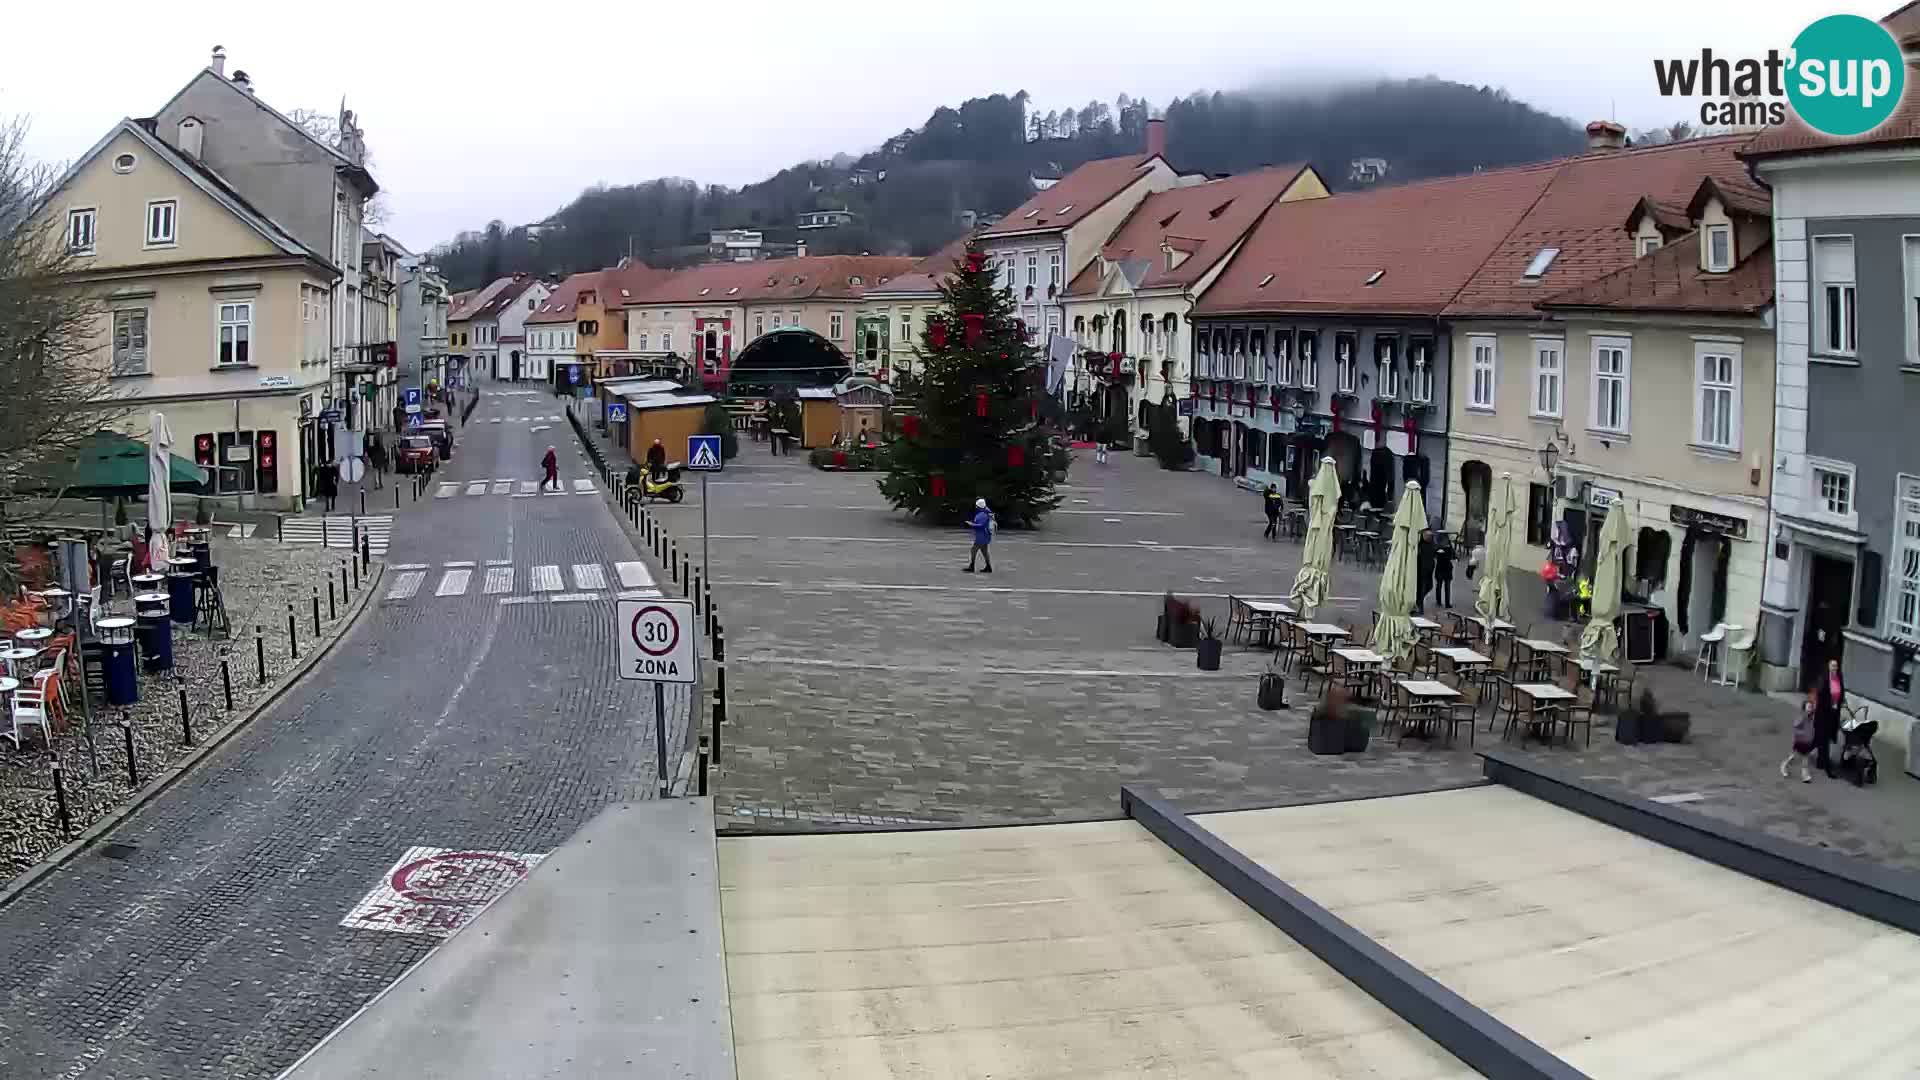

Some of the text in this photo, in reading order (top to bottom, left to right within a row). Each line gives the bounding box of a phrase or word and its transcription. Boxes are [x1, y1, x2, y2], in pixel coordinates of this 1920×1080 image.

[410, 391, 417, 402] P
[644, 621, 668, 642] 30
[635, 659, 678, 676] ZONA
